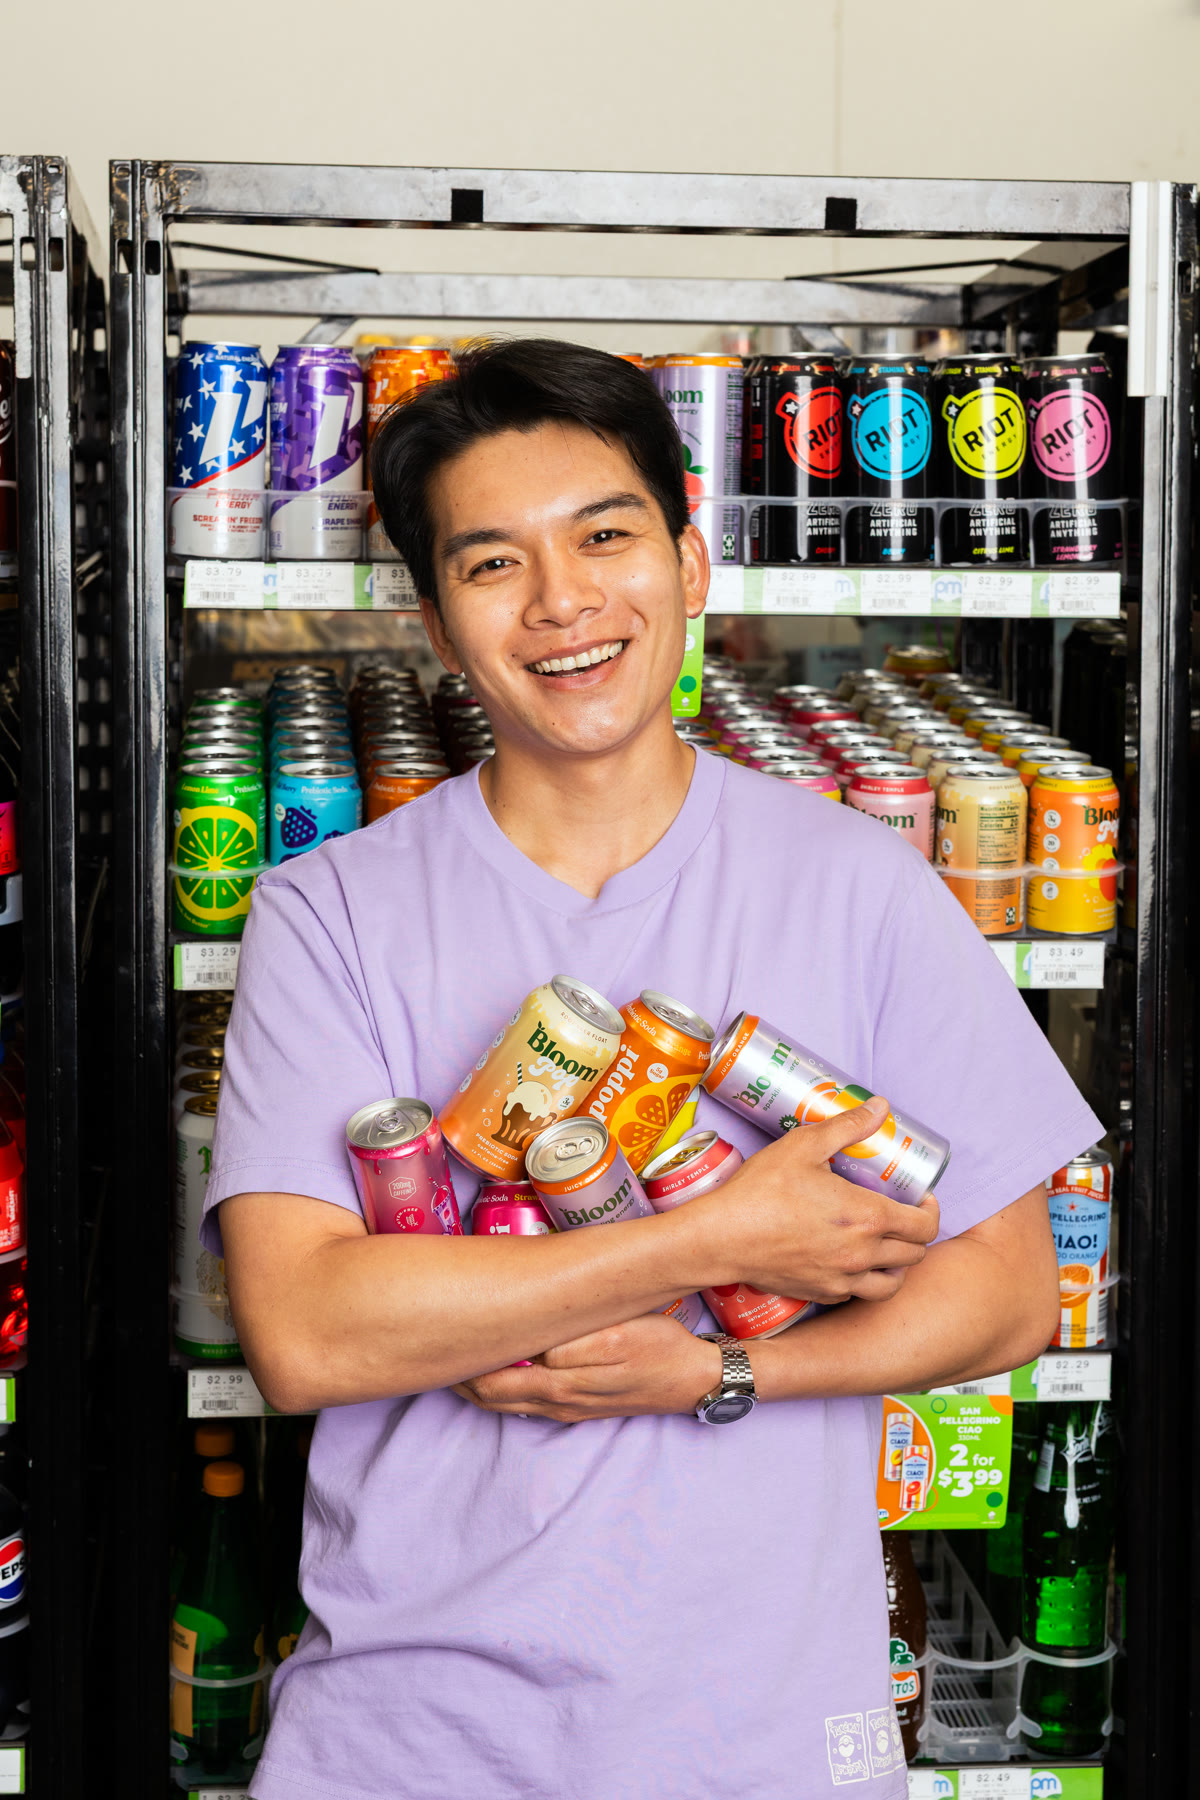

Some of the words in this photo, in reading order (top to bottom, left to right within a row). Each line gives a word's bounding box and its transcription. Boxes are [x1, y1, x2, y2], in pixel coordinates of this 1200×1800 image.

[803, 408, 842, 451] RIOT
[864, 408, 918, 453] RIOT
[962, 408, 1016, 453] RIOT
[1041, 409, 1095, 455] RIOT
[215, 501, 252, 509] EERGY
[328, 503, 358, 511] ENERGY
[870, 501, 918, 517] ZERO
[870, 518, 917, 527] ARTIFICIAL
[969, 517, 1016, 527] ARTIFICIAL
[1050, 518, 1097, 528] ARTIFICIAL
[870, 528, 917, 537] ANYTHING
[969, 527, 1016, 537] ANYTHING
[1050, 528, 1098, 538] ANYTHING
[206, 567, 242, 577] $3.79
[295, 568, 332, 578] $3.79
[876, 573, 912, 583] $2.99
[978, 575, 1013, 586] $2.99
[1064, 575, 1100, 586] $2.99
[181, 783, 200, 793] Lemon
[201, 785, 219, 794] Lime
[301, 785, 332, 795] Prebiotic
[333, 786, 348, 794] Soda
[397, 785, 415, 794] Soda
[860, 783, 881, 793] SHIRLEY
[883, 785, 905, 793] TEMPLE
[201, 947, 237, 957] $3.29
[1049, 947, 1084, 957] $3.49
[640, 1020, 657, 1037] Soda
[591, 1033, 608, 1044] FLOAT
[665, 1037, 692, 1056] Orange
[527, 1026, 599, 1083] Bloom
[720, 1058, 733, 1076] JUICY
[732, 1032, 750, 1057] ORANGE
[528, 1056, 580, 1091] Pop
[737, 1041, 793, 1109] Bloom
[589, 1043, 640, 1124] poppi
[475, 1132, 504, 1155] PREBIOTIC
[504, 1152, 519, 1162] SODA
[477, 1144, 509, 1165] caffeine-free
[564, 1182, 583, 1192] JUICY
[584, 1162, 609, 1184] ORANGE
[662, 1178, 686, 1193] SHIRLEY
[686, 1164, 710, 1181] TEMPLE
[1071, 1186, 1088, 1195] FRUIT
[491, 1194, 509, 1202] Soda
[563, 1177, 632, 1226] Bloom
[1069, 1251, 1098, 1260] ORANGE
[738, 1303, 767, 1319] PREBIOTIC
[747, 1303, 781, 1323] caffeine-free
[1056, 1360, 1090, 1370] $2.29
[207, 1374, 243, 1385] $2.99
[959, 1407, 981, 1415] SAN
[939, 1416, 1001, 1425] PELLEGRINO
[957, 1426, 982, 1434] CIAO
[949, 1443, 969, 1466] 2
[972, 1453, 996, 1466] for
[976, 1773, 1011, 1783] $2.49
[1031, 1778, 1057, 1800] pm
